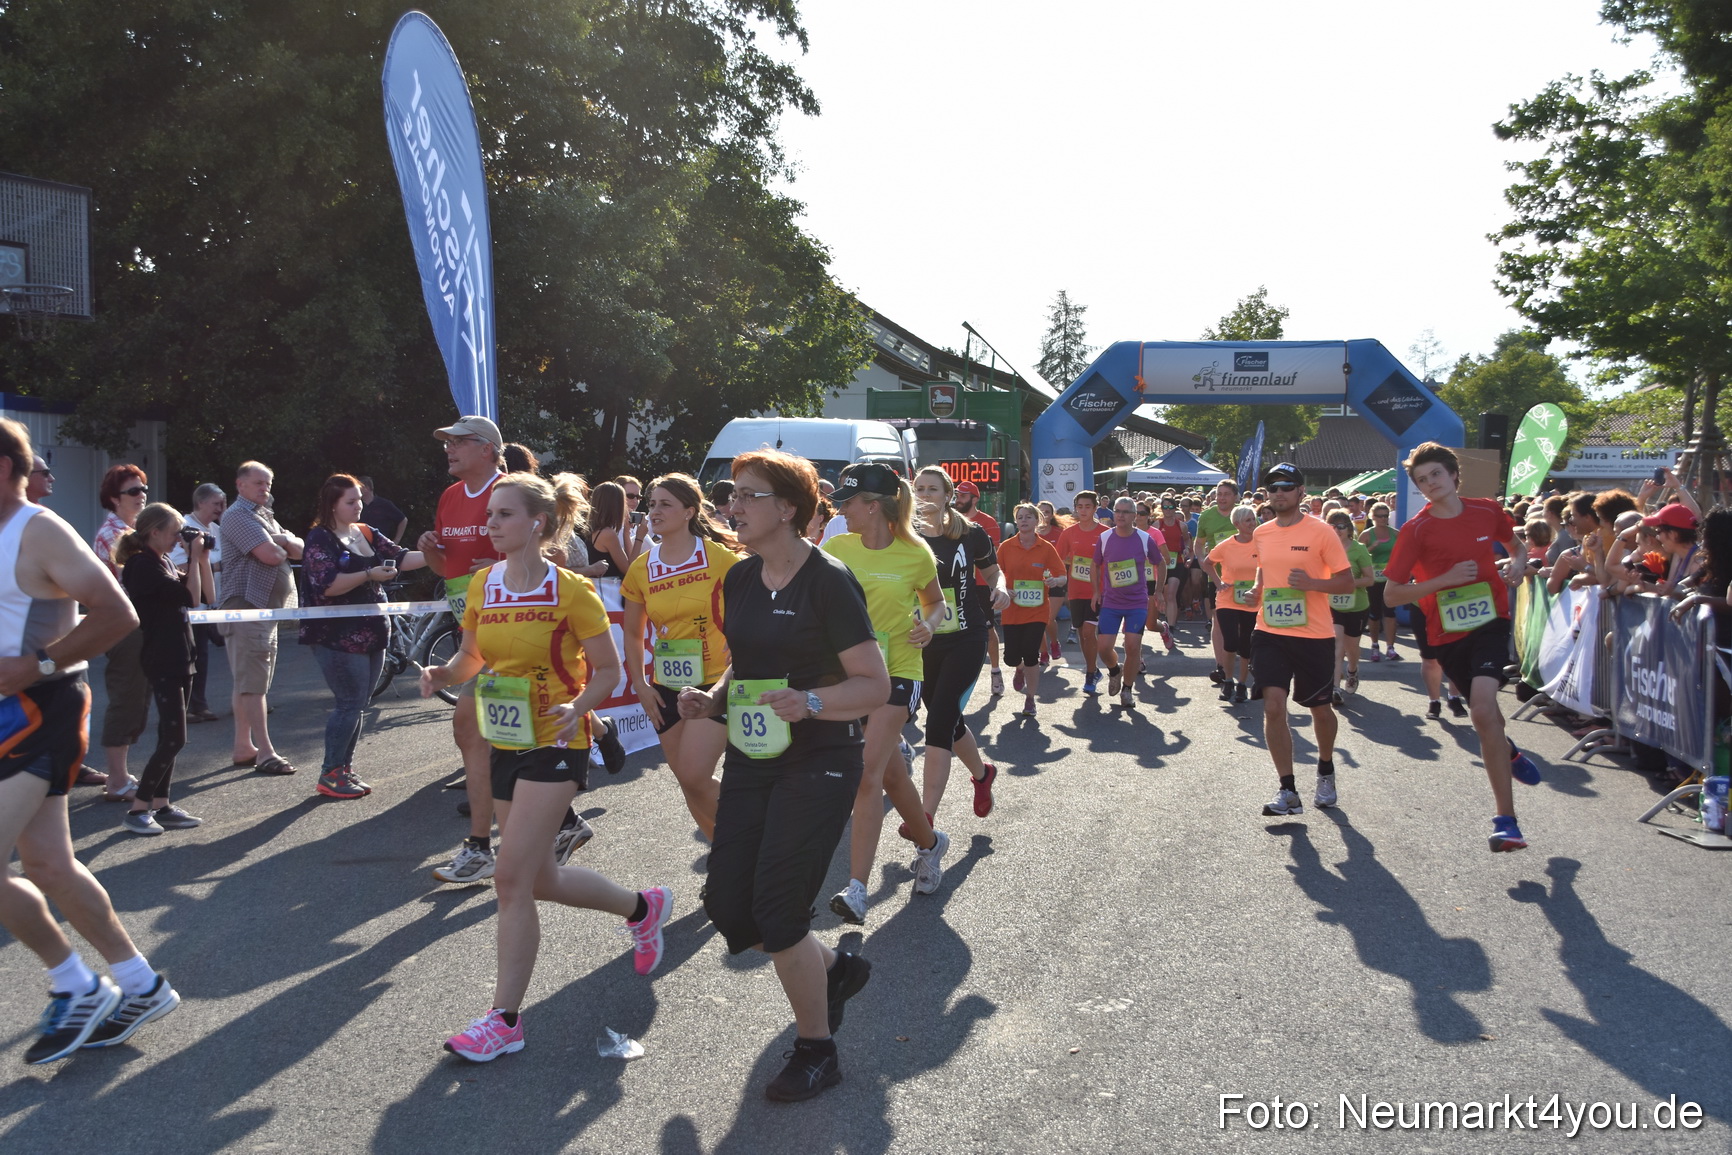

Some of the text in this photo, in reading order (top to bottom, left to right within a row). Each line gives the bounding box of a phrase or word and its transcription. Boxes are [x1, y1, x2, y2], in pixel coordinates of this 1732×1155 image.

[1241, 357, 1267, 365] Fischer
[1221, 371, 1298, 386] firmenlauf
[1079, 399, 1118, 408] Fischer
[1536, 438, 1558, 462] AOK
[1578, 450, 1608, 460] Jura
[1621, 450, 1668, 460] Hallen
[1510, 456, 1536, 484] AOK
[1074, 565, 1090, 576] 105
[1114, 570, 1132, 580] 290
[649, 580, 674, 595] MAX
[678, 572, 711, 586] BÖGL
[1016, 590, 1041, 600] 1032
[1333, 595, 1350, 604] 517
[480, 608, 558, 625] MAX BÖGL
[1266, 603, 1302, 617] 1454
[1446, 600, 1490, 621] 1052
[663, 660, 693, 677] 886
[488, 703, 521, 728] 922
[742, 712, 767, 737] 93
